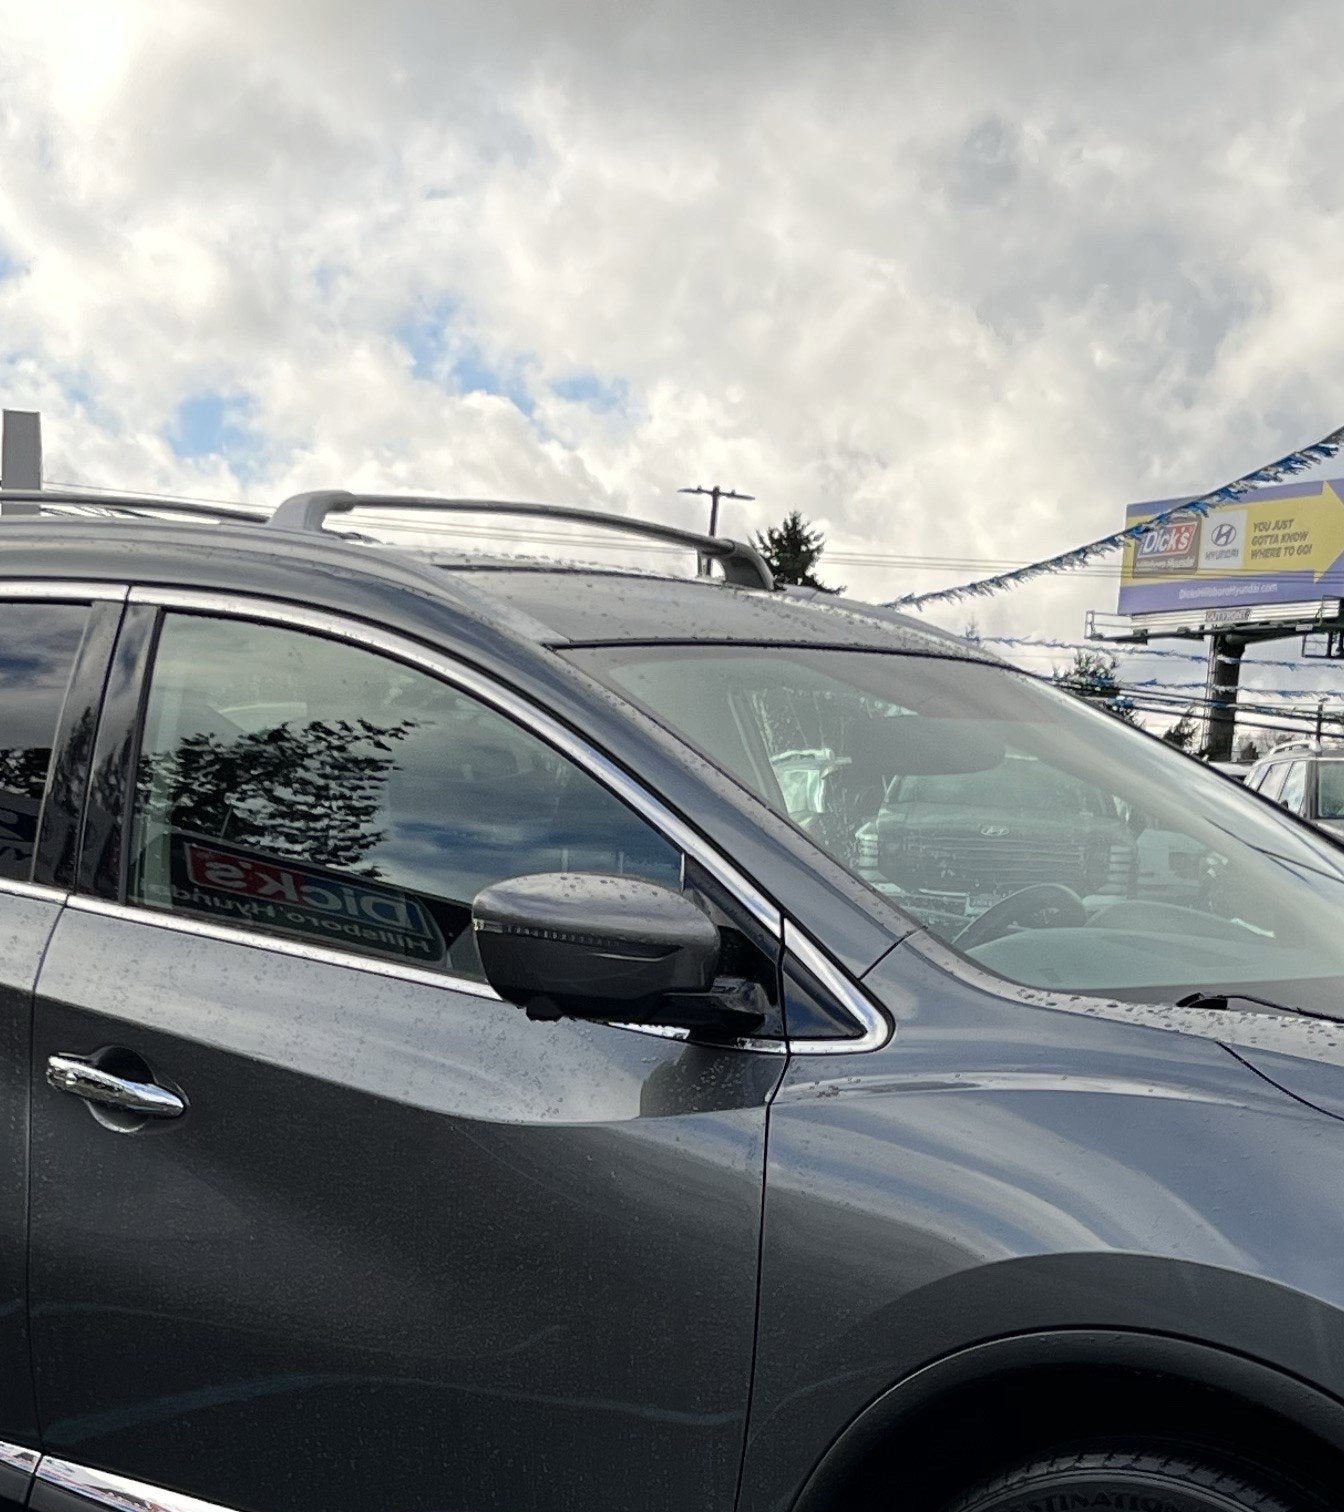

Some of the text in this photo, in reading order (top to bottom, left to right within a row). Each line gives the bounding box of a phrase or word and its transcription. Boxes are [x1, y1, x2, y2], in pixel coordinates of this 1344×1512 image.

[1253, 518, 1295, 533] YOU JUST
[1142, 526, 1190, 554] Dick's
[1251, 530, 1310, 547] GOTTA KNOW
[1205, 548, 1239, 561] HYUNDAI
[1250, 543, 1313, 560] WHERE TO GO!
